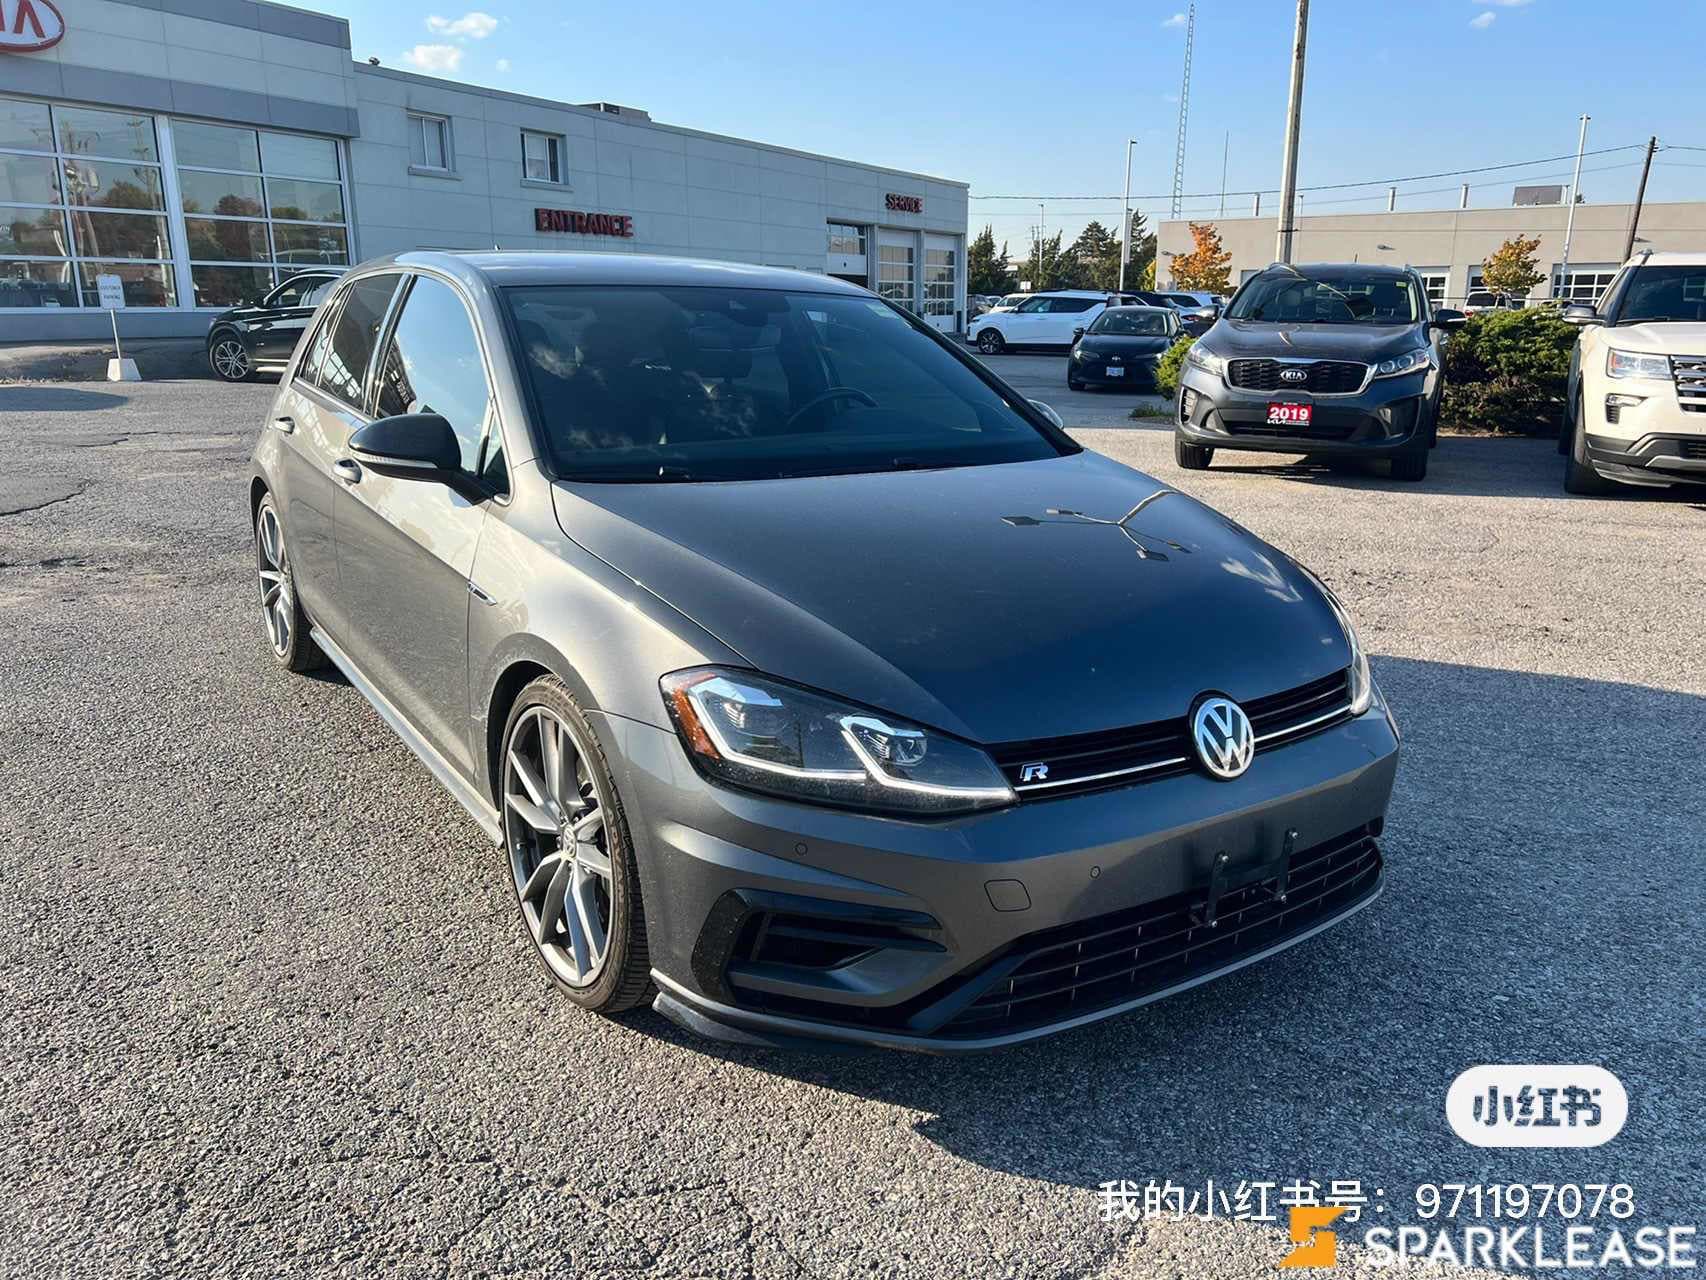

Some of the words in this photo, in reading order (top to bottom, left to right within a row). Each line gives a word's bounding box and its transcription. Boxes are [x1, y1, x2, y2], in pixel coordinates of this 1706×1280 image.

[885, 193, 923, 213] SERVICE
[535, 208, 633, 237] ENTRANCE
[1269, 407, 1309, 420] 2019
[1020, 762, 1049, 782] R
